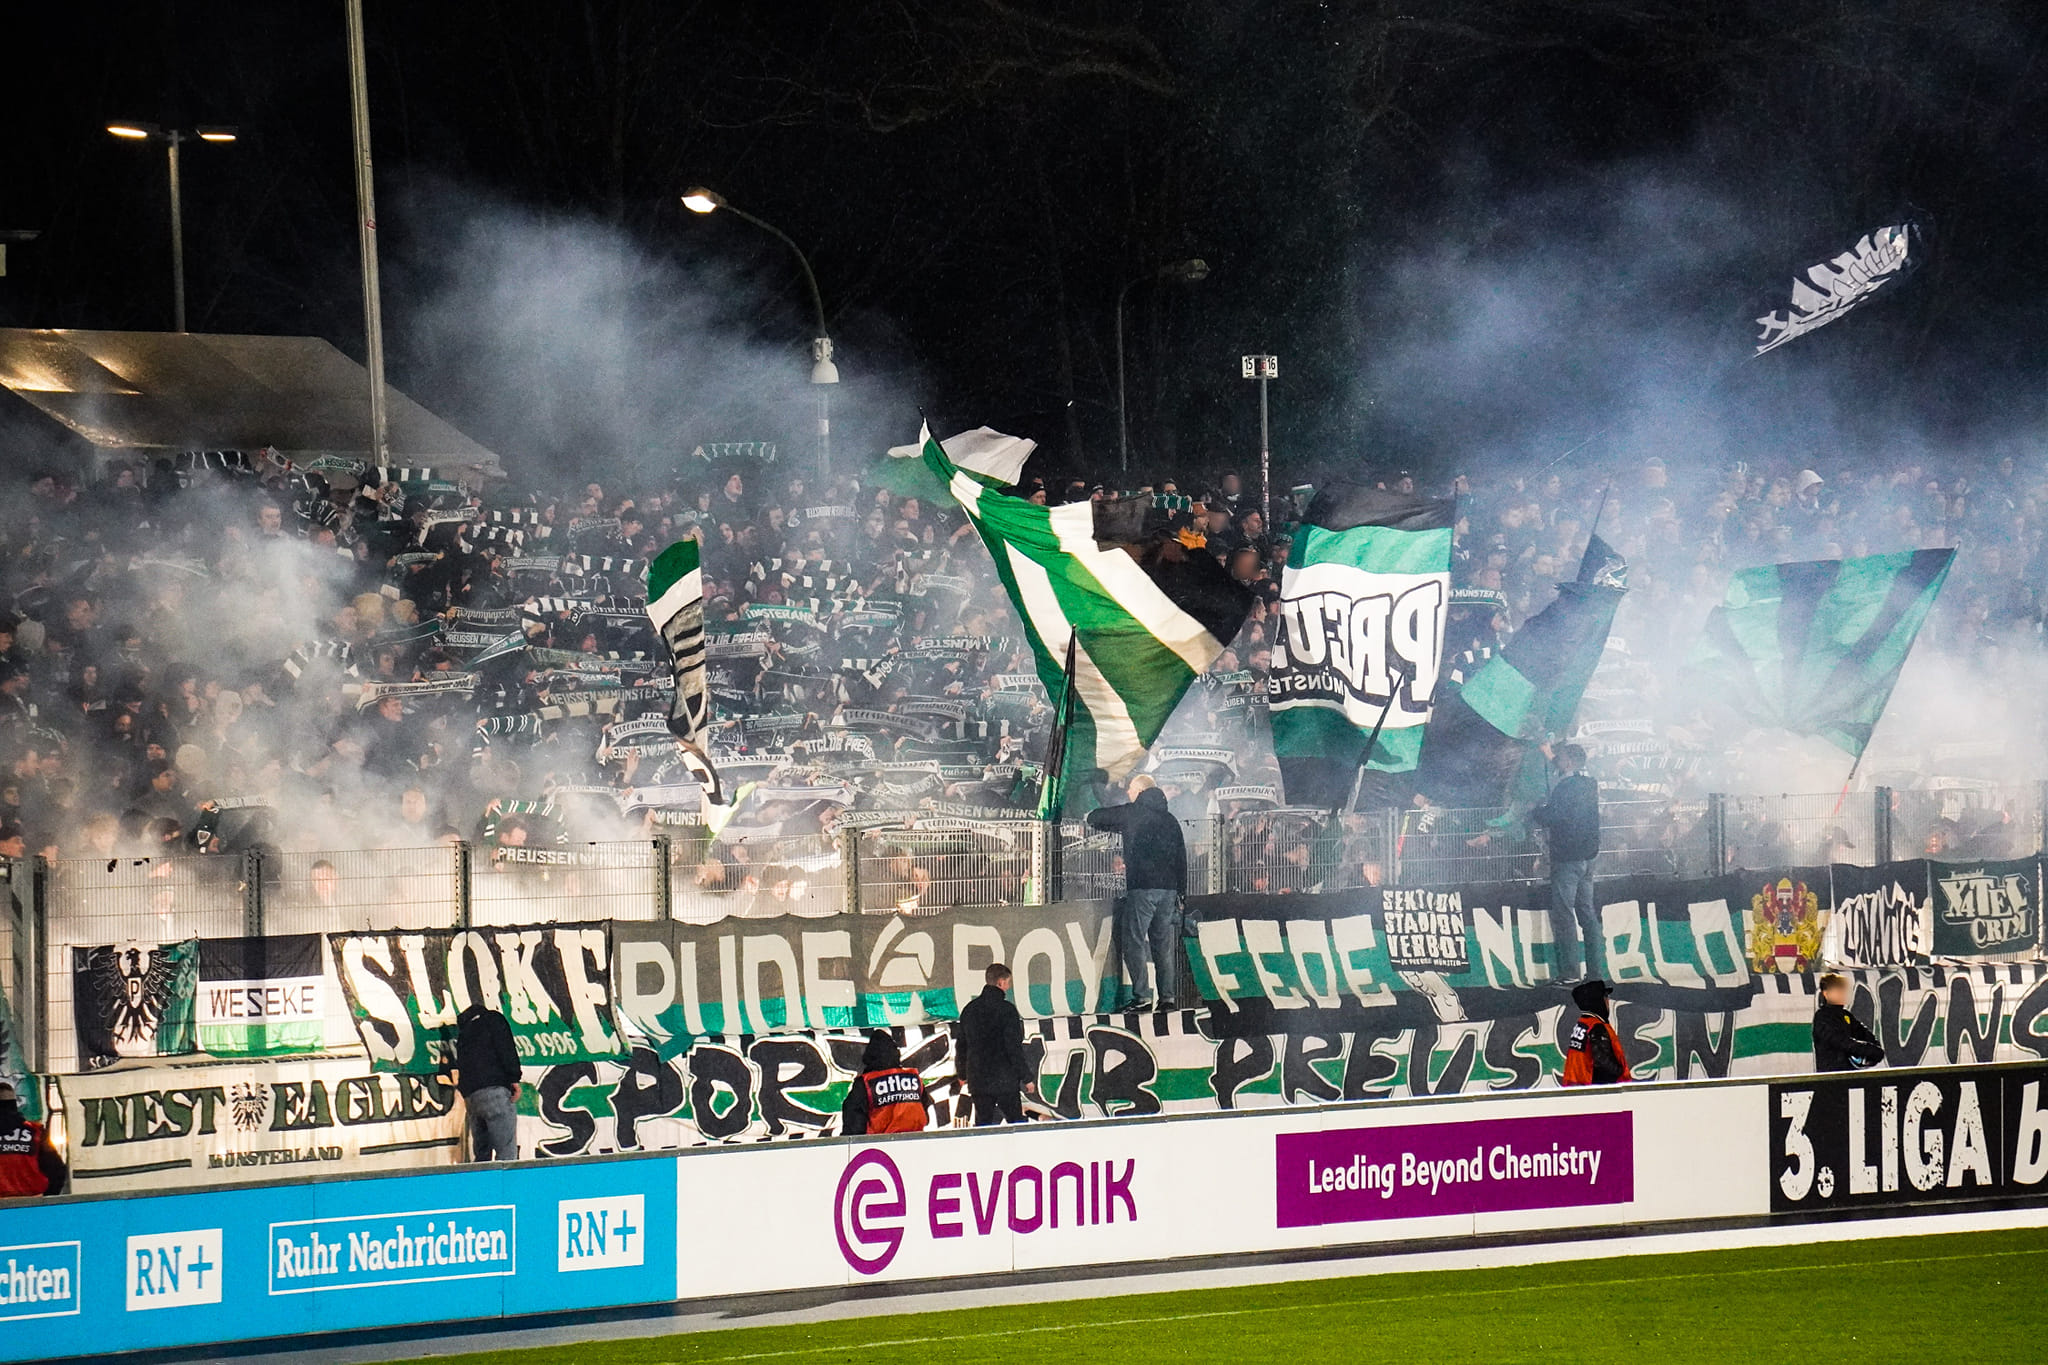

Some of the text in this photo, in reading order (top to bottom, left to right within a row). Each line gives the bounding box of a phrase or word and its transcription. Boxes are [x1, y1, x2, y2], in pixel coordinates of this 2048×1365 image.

[1244, 357, 1254, 370] 15
[1267, 357, 1276, 370] 16
[875, 1074, 919, 1096] atlas
[80, 1086, 225, 1147] WEST
[1779, 1080, 1993, 1201] 3. LIGA
[928, 1157, 1138, 1239] EVONIK
[1309, 1142, 1603, 1199] Leading Beyond Chemistry
[276, 1220, 508, 1279] Ruhr Nachrichten
